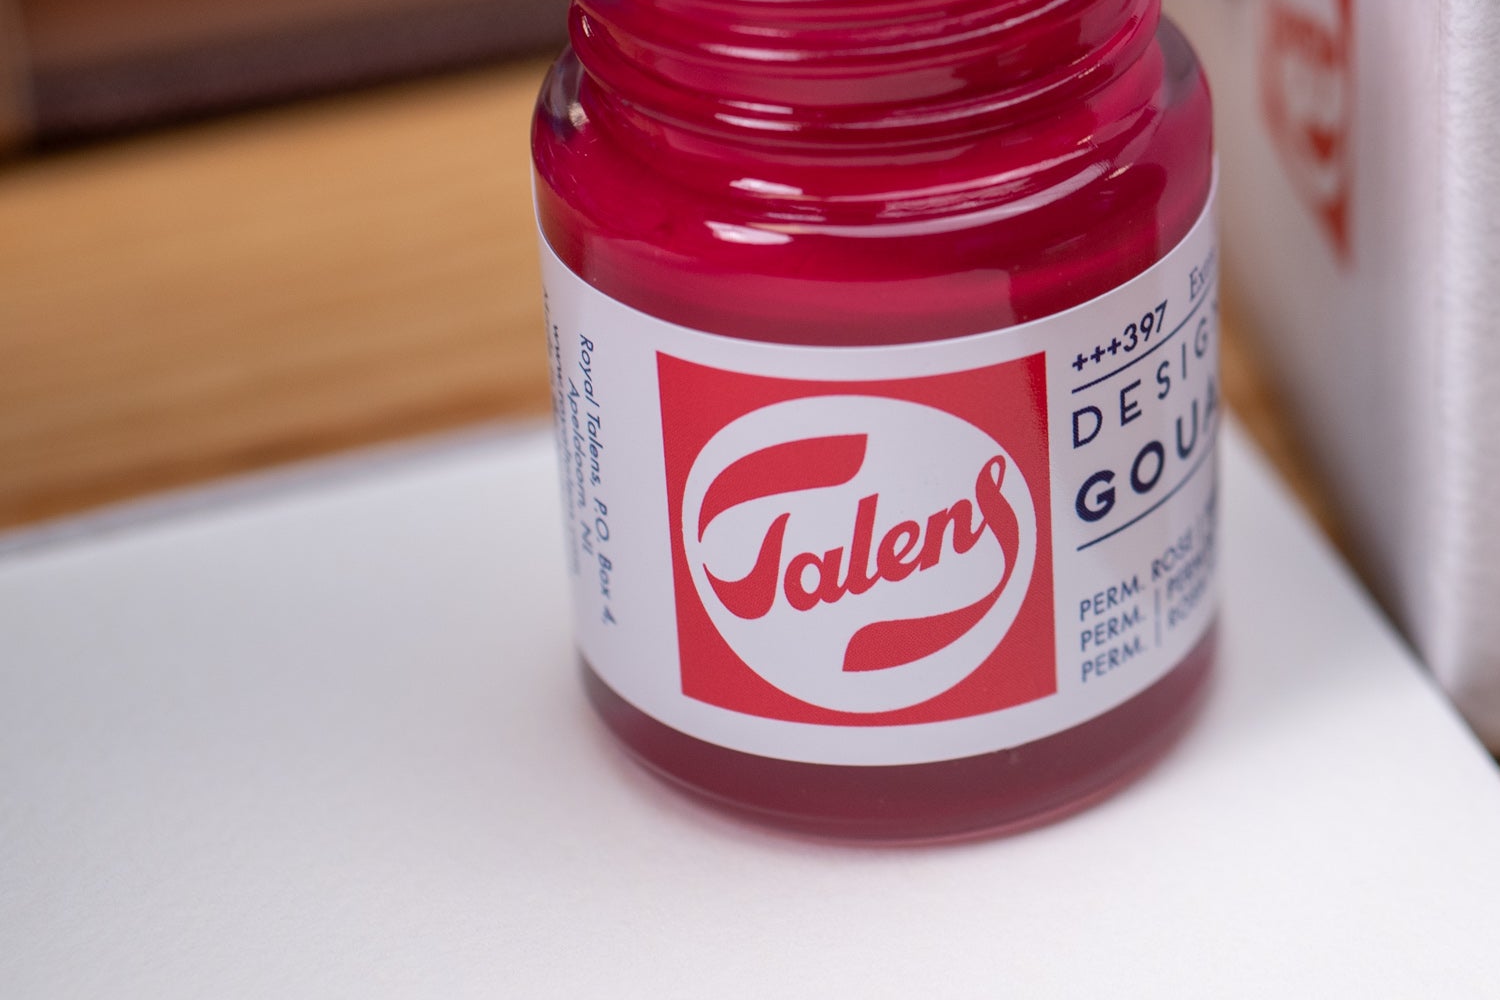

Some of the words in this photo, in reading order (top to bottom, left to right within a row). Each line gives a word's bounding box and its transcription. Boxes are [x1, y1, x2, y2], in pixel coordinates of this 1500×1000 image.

[579, 333, 601, 408] Royal
[1072, 303, 1218, 450] DESIG
[587, 411, 604, 487] Talens,
[593, 495, 611, 543] P.O.
[697, 433, 1020, 672] Talens
[598, 552, 613, 600] Box
